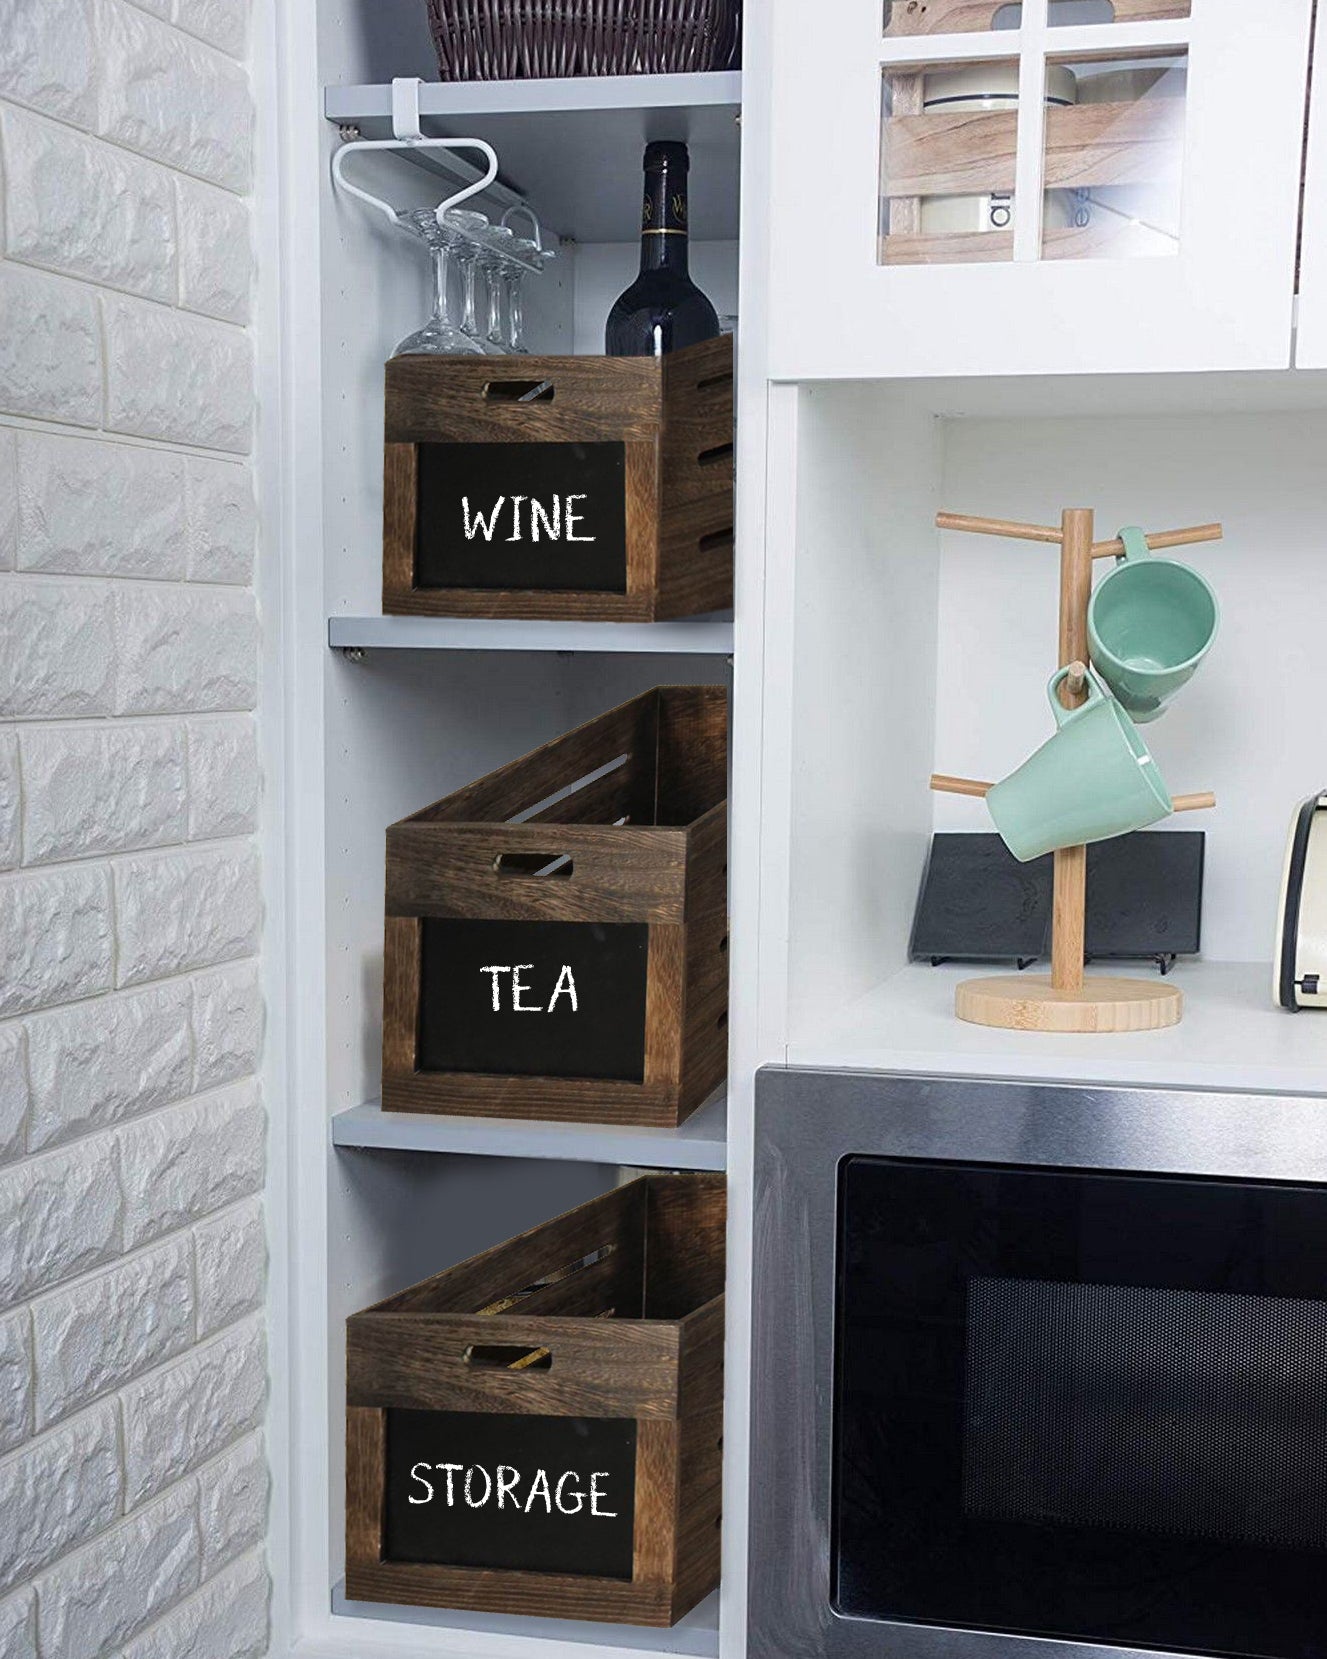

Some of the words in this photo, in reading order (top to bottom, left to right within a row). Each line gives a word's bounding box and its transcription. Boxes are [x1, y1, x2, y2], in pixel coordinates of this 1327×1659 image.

[462, 494, 597, 543] WINE
[480, 963, 578, 1013] TEA
[408, 1462, 618, 1517] STORAGE
